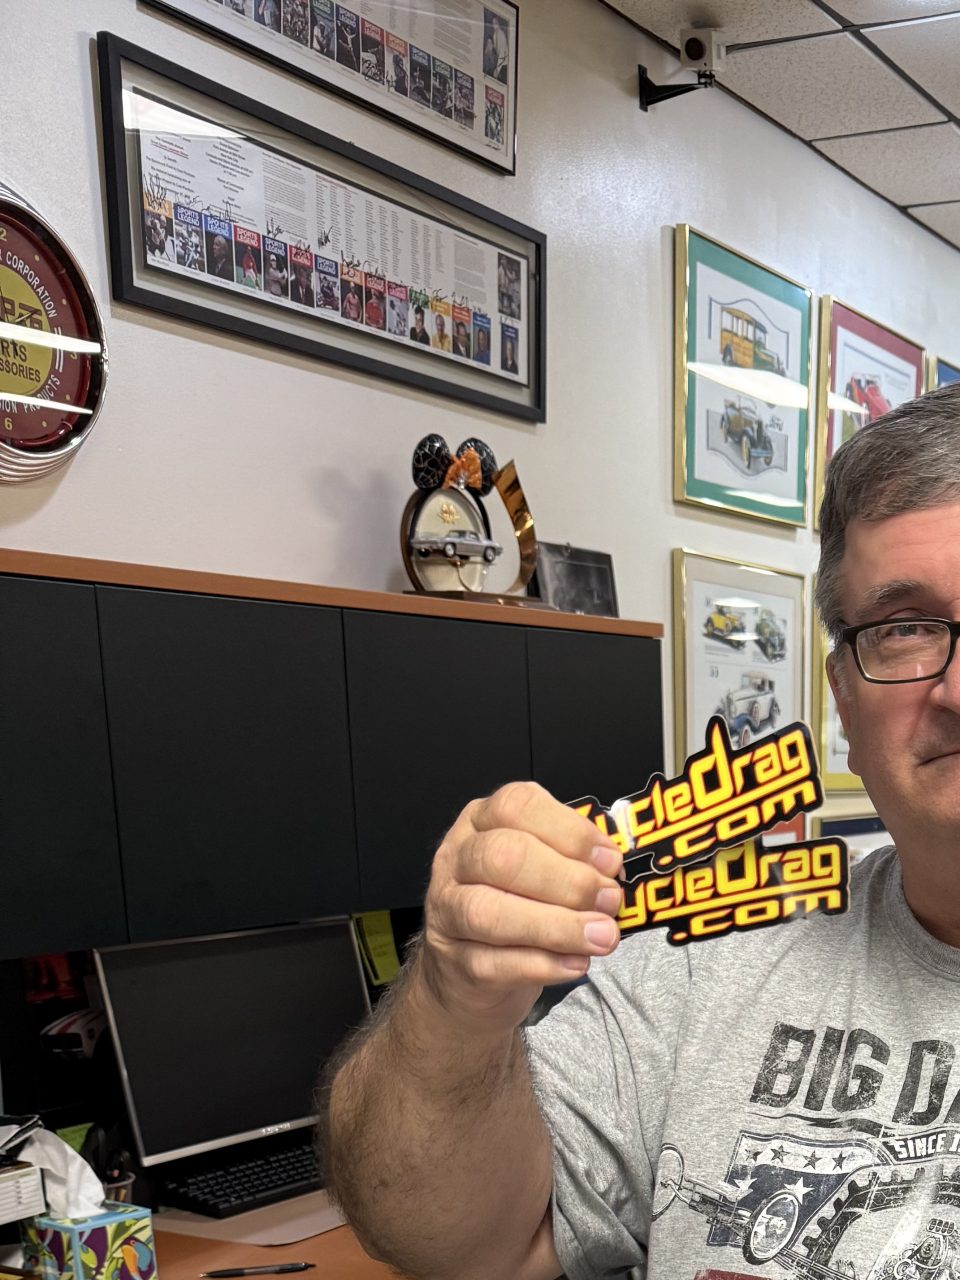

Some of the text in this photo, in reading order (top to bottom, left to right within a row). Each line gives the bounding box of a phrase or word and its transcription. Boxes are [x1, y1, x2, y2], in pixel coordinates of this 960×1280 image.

[6, 250, 58, 319] CORPORATION
[0, 358, 41, 383] SSORIES
[4, 417, 13, 431] 6
[658, 780, 817, 867] .com
[672, 889, 842, 941] .com
[749, 1020, 890, 1113] BIG
[892, 1133, 947, 1159] SINCE
